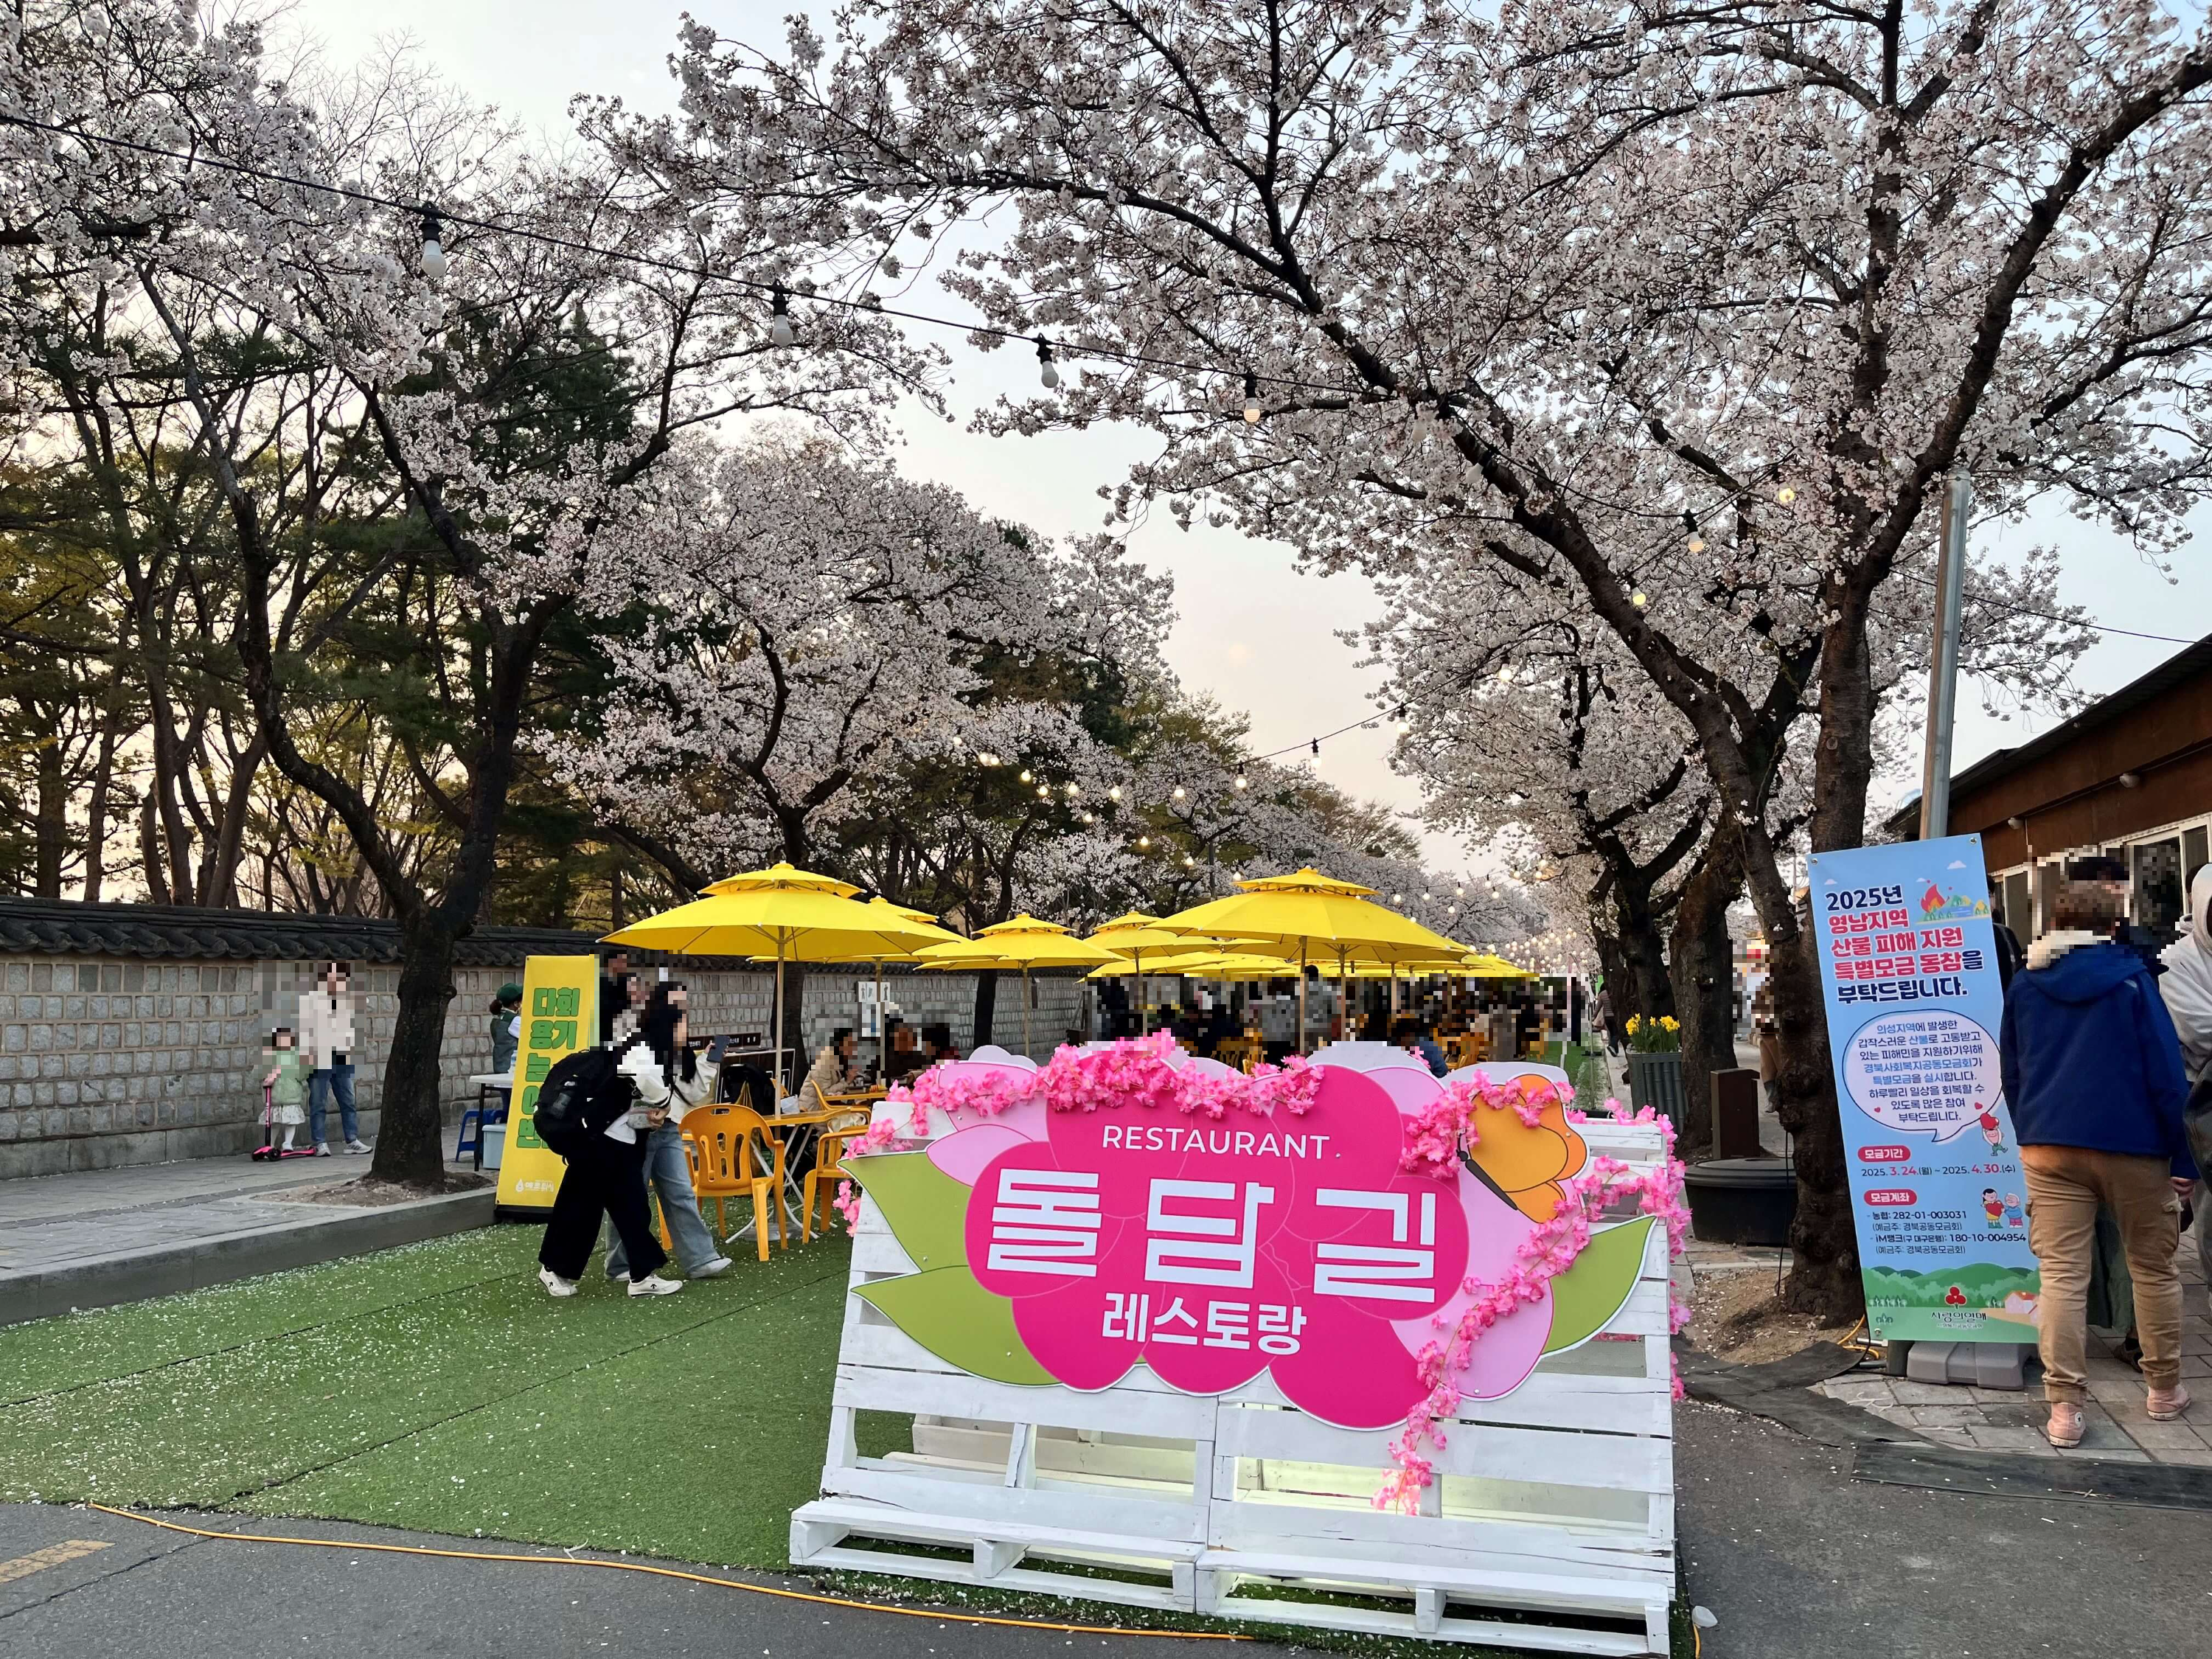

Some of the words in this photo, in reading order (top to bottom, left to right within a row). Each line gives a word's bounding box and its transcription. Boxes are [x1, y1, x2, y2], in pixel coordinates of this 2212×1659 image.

[1826, 885, 1902, 911] 2025년
[1829, 908, 1909, 934] 영남지역
[1832, 936, 1871, 957] 산불
[1875, 931, 1916, 953] 피해
[1920, 926, 1964, 949] 지원
[1834, 956, 1916, 981] 특별모금
[1920, 950, 1983, 974] 동참을
[1837, 975, 1968, 1004] 부탁드립니다.
[1877, 1022, 1925, 1034] 의성지역에
[1927, 1020, 1958, 1032] 발생한
[1858, 1036, 1907, 1048] 갑작스러운
[1909, 1034, 1938, 1046] 산불로
[1941, 1032, 1981, 1043] 고통받고
[1860, 1051, 1879, 1061] 있는
[1882, 1048, 1921, 1060] 피해민을
[1923, 1044, 1983, 1057] 지원하기위해
[1863, 1057, 1983, 1074] 경북사회복지공동모금회가
[1873, 1074, 1921, 1085] 특별모금을
[1924, 1071, 1978, 1083] 실시합니다.
[1868, 1088, 1907, 1099] 하루빨리
[1910, 1085, 1940, 1096] 일상을
[1942, 1084, 1972, 1095] 회복할
[1975, 1083, 1985, 1093] 수
[1891, 1099, 1921, 1110] 있도록
[1922, 1098, 1943, 1109] 많은
[1945, 1097, 1966, 1108] 참여
[1899, 1111, 1961, 1123] 부탁드립니다.
[1102, 1125, 1329, 1160] RESTAURANT
[1865, 1149, 1904, 1159] 모금기간
[1871, 1192, 1910, 1203] 모금계좌
[1893, 1211, 1966, 1220] 282-01-003031
[1950, 1233, 2026, 1242] 180-10-004954
[1102, 1291, 1307, 1356] 레스토랑
